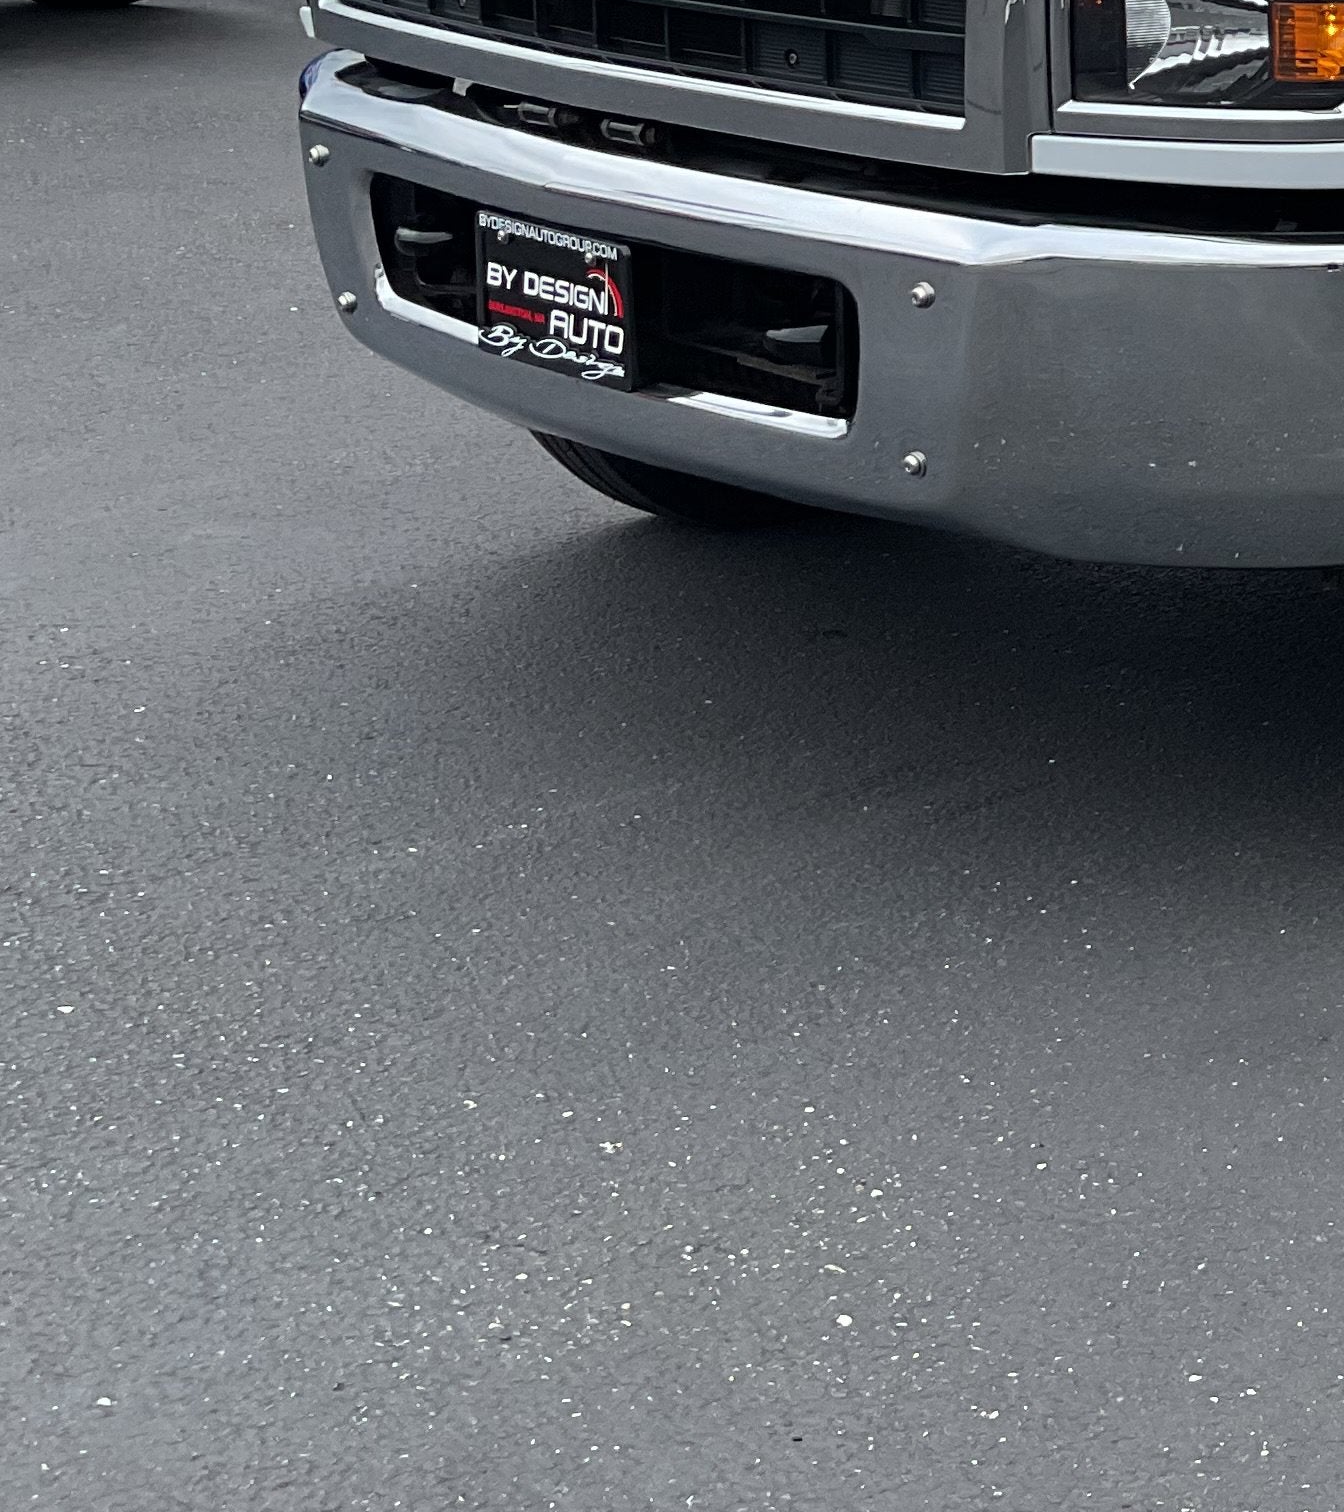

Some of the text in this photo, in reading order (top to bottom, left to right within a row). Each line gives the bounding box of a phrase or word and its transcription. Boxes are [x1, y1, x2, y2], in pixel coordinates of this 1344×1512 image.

[479, 213, 618, 261] BYDESIGNAUTOGROUP.COM
[486, 261, 517, 290] BY
[523, 271, 605, 315] DESIGN
[479, 325, 626, 380] By Design
[550, 309, 625, 355] AUTO
